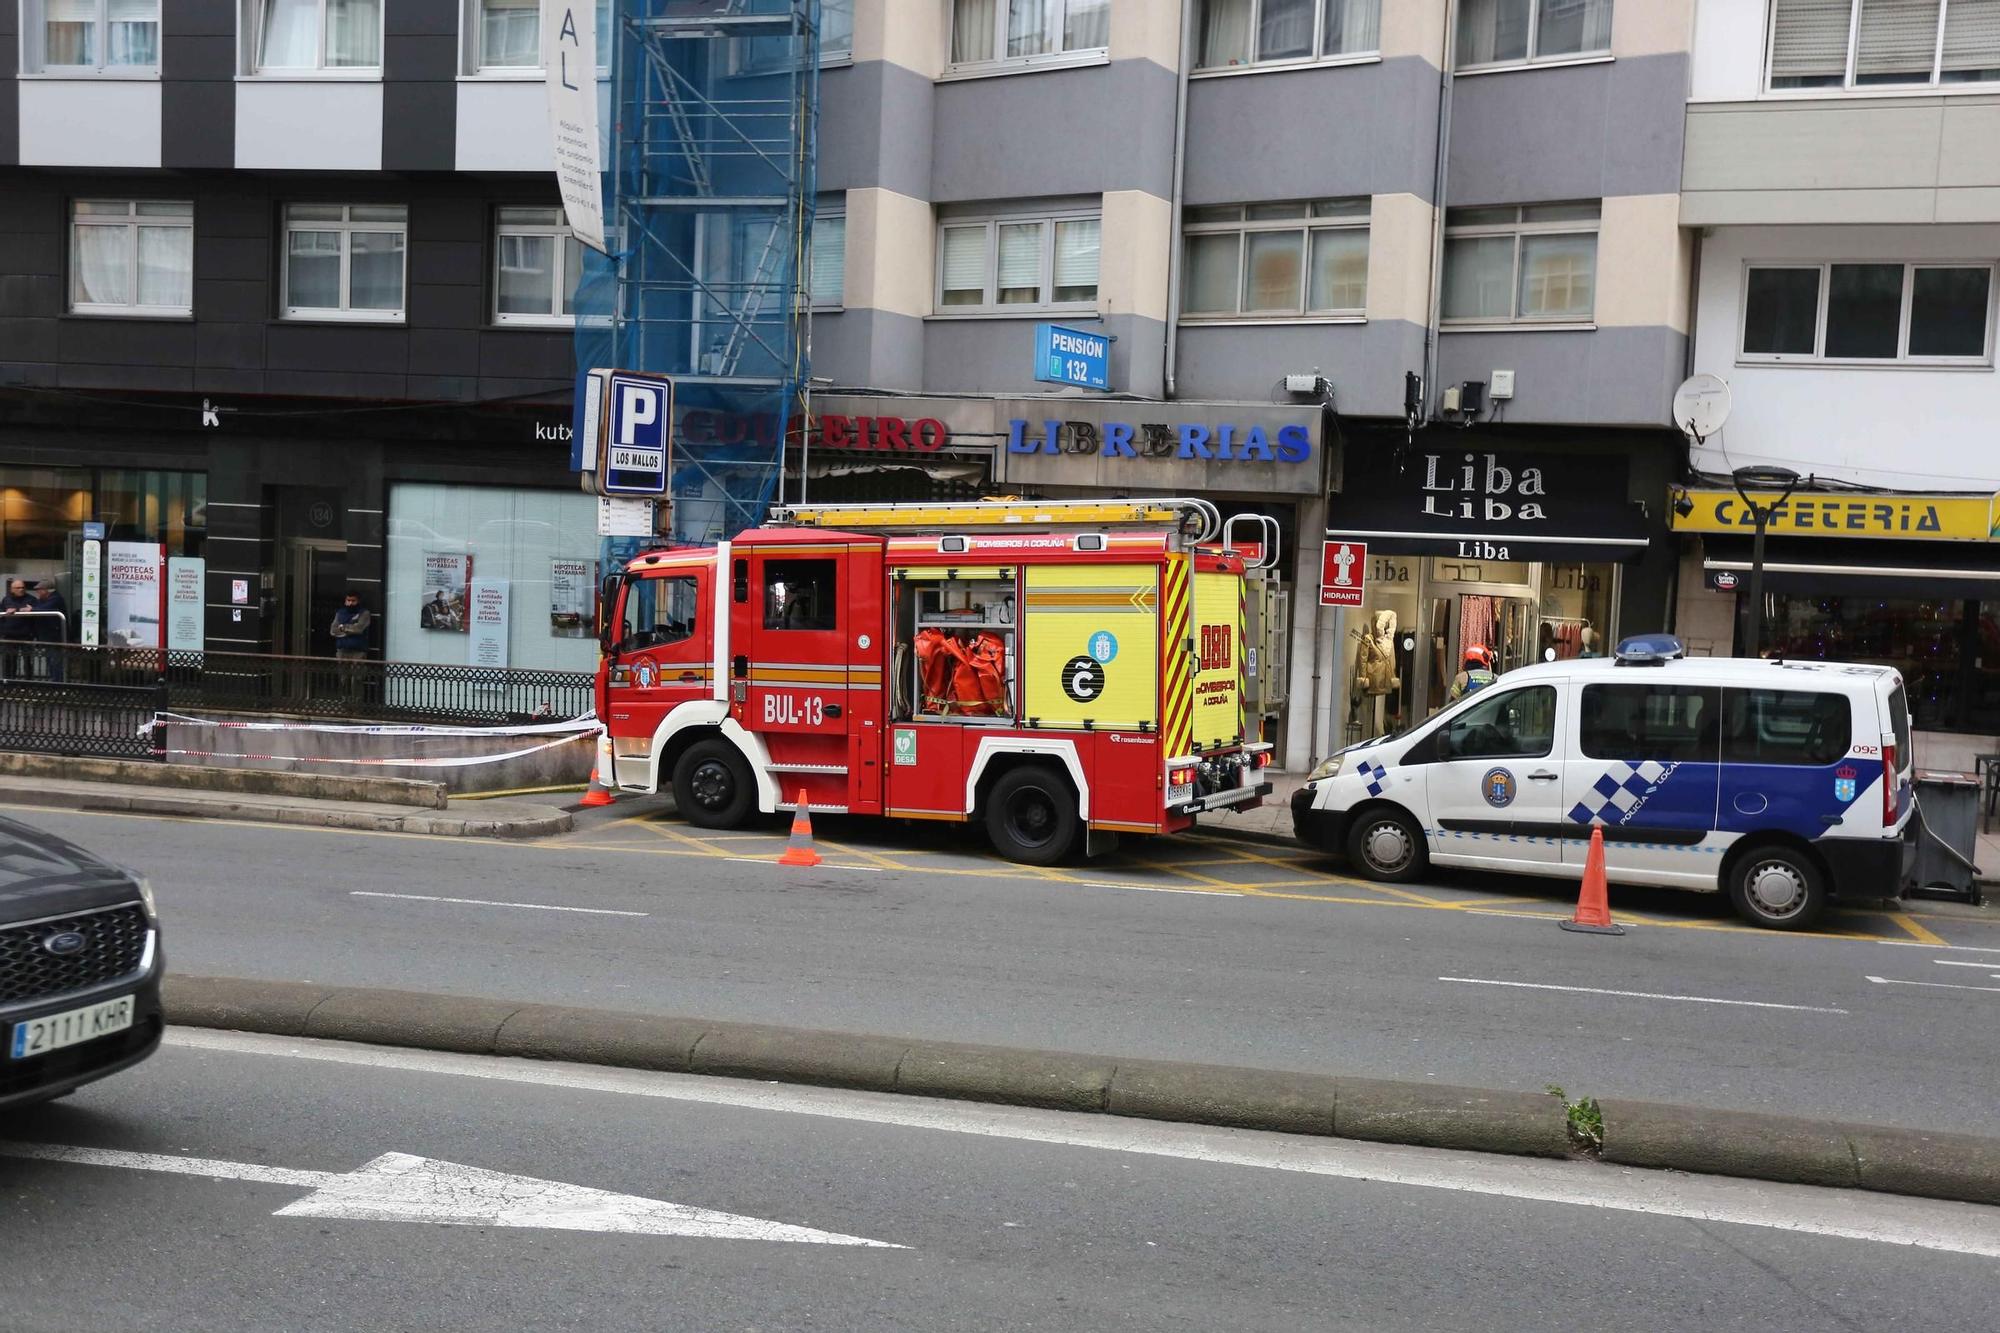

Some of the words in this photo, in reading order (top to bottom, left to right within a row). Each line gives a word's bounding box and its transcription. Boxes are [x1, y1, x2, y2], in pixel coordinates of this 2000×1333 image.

[1052, 333, 1103, 358] PENSIÓN
[1067, 360, 1087, 382] 132
[621, 386, 656, 444] P
[1008, 419, 1311, 463] LIBRERIAS
[616, 452, 629, 465] LOS
[632, 454, 658, 468] MALLOS
[1421, 453, 1546, 495] Liba
[1714, 500, 1942, 531] CAFETERIA
[1458, 541, 1510, 560] Liba
[112, 565, 154, 574] HIPOTECAS
[1323, 591, 1360, 601] HIDRANTE
[1201, 624, 1231, 670] 080
[764, 694, 823, 726] BUL-13
[896, 755, 916, 763] DESA
[1852, 744, 1878, 754] 092
[1656, 760, 1683, 784] LOCAL
[30, 1012, 86, 1050] 2111
[92, 1001, 128, 1034] KHR
